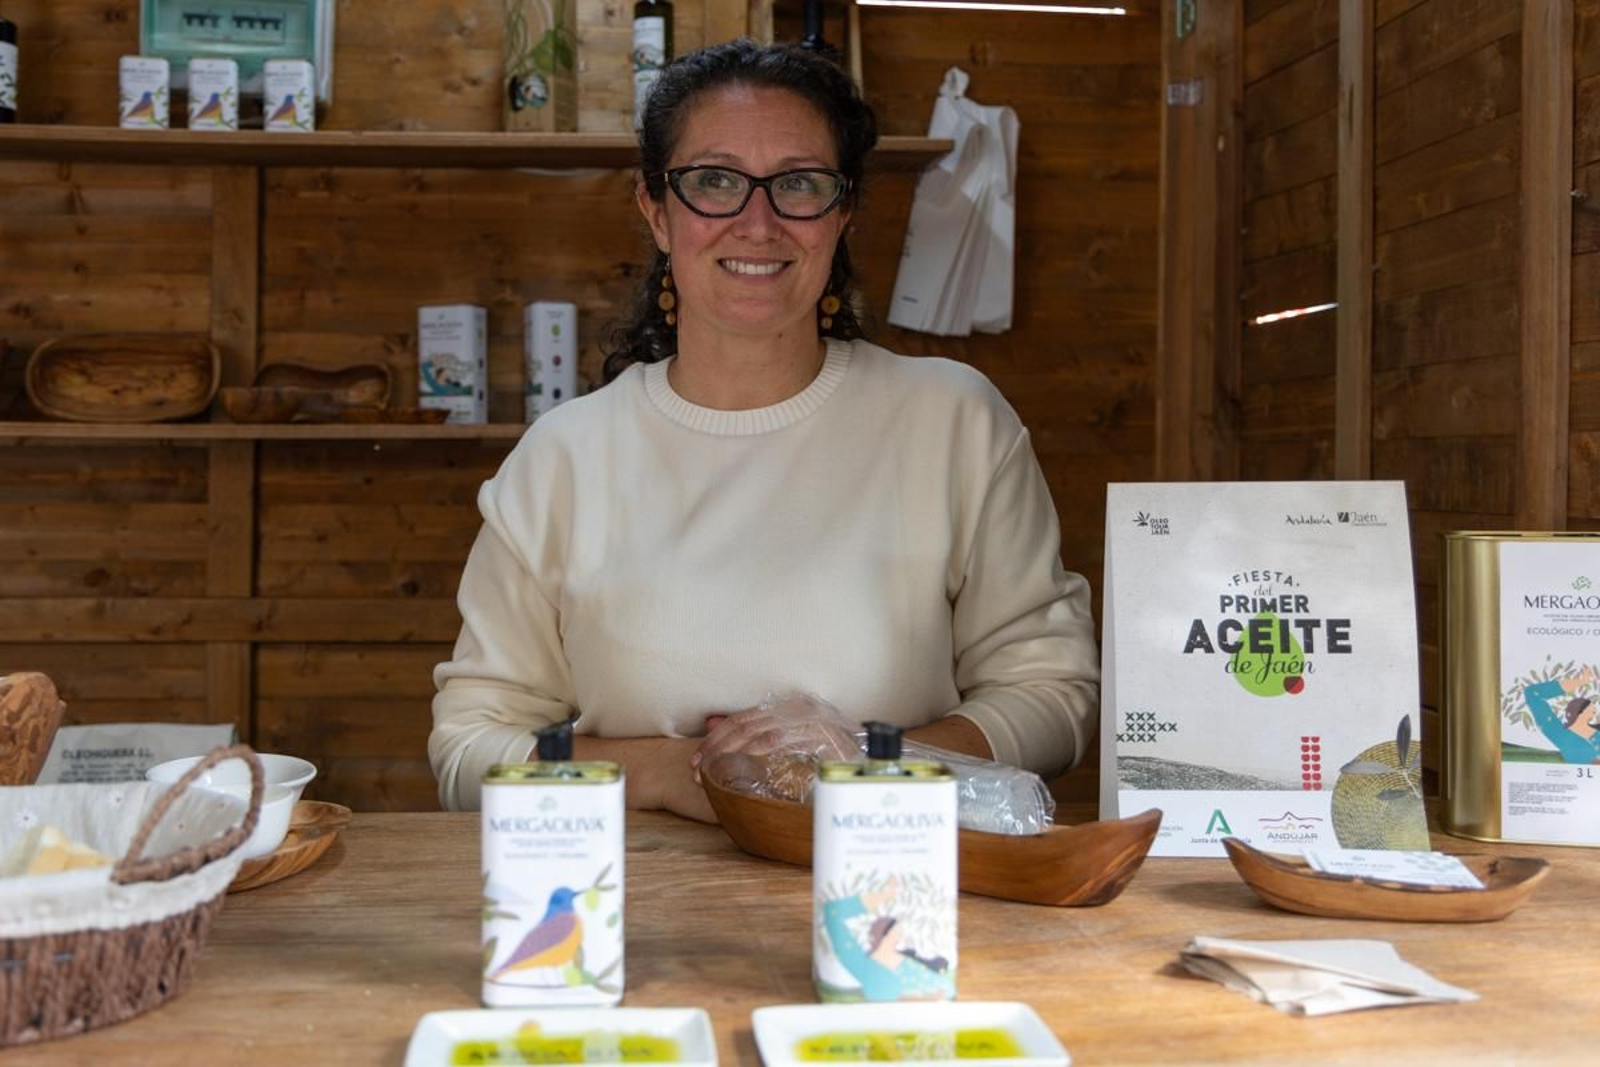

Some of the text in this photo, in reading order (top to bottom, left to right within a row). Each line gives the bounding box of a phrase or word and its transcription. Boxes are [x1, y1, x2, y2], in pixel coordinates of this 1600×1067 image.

[1351, 511, 1377, 523] Jaén
[1254, 584, 1273, 596] del
[1219, 594, 1310, 613] PRIMER
[1183, 618, 1352, 654] ACEITE
[1527, 626, 1584, 636] ECOLÓGICO
[1224, 641, 1316, 684] de Jaén
[1576, 767, 1584, 778] 3
[1587, 767, 1594, 778] L
[489, 816, 606, 832] MERGAOLIVA
[831, 812, 946, 829] MERGAOLIVA
